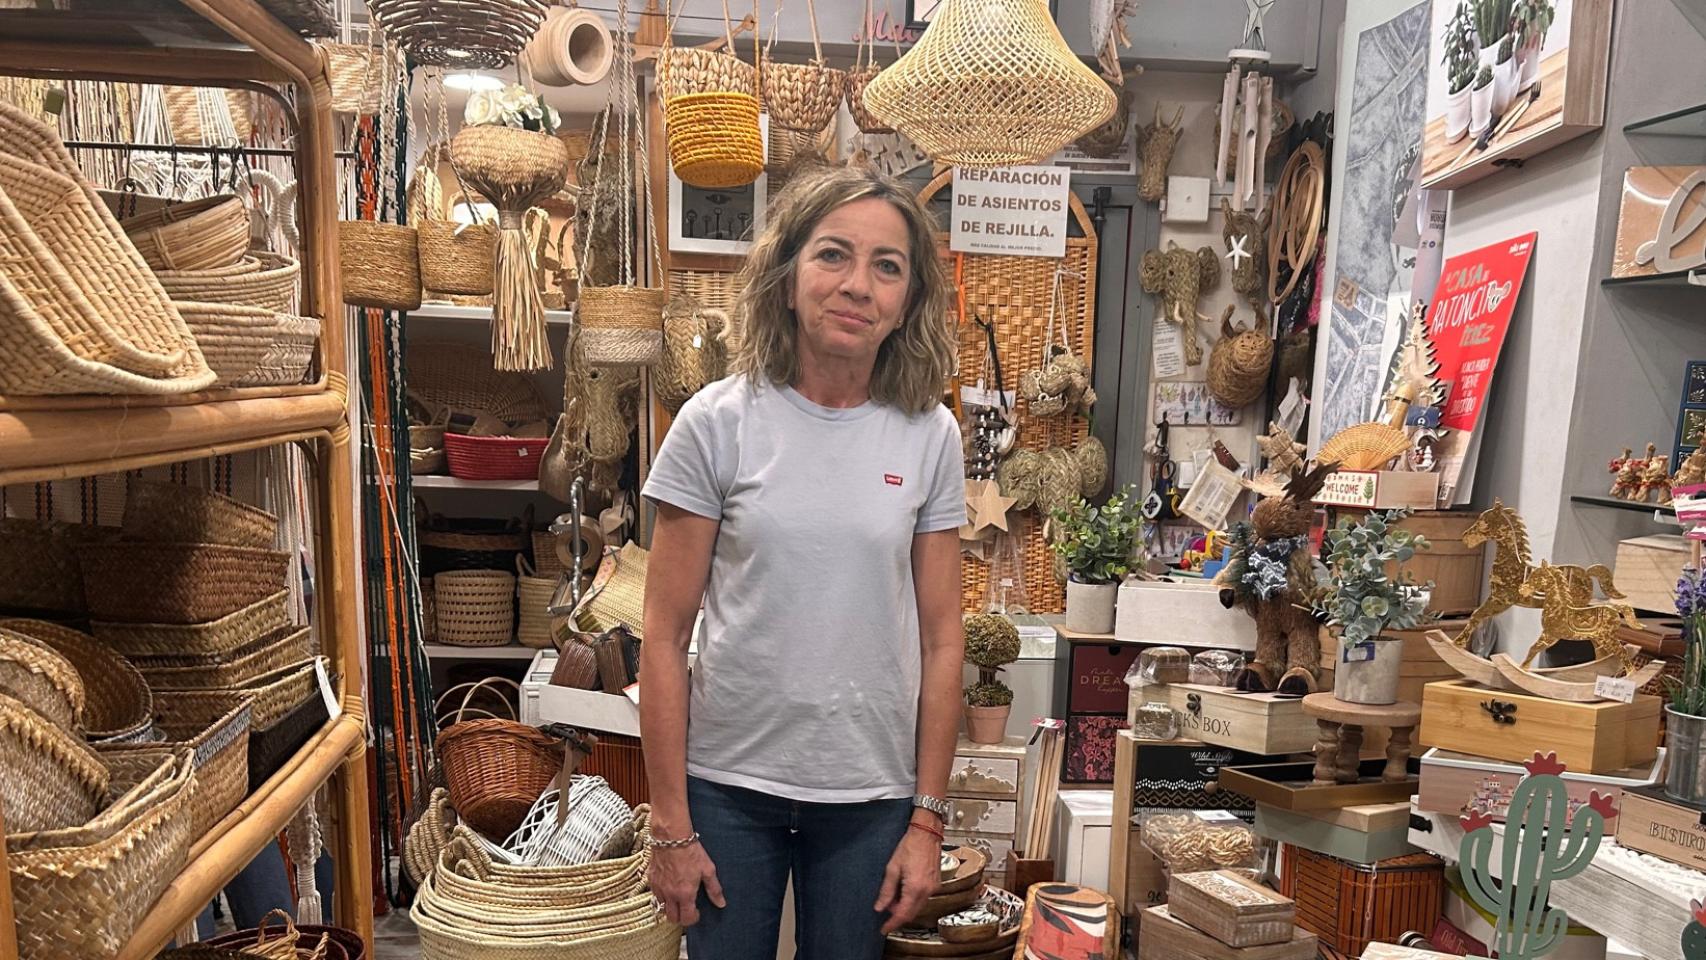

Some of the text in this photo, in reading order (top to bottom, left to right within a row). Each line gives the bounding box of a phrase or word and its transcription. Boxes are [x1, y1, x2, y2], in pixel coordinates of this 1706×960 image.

[960, 168, 1062, 186] REPARACIÓN
[957, 194, 1061, 212] DE ASIENTOS
[961, 220, 1054, 237] DE REJILLA.
[1447, 264, 1483, 292] CASA
[1326, 482, 1359, 495] WELCOME
[1080, 675, 1121, 685] DREA
[1202, 716, 1231, 737] BOX
